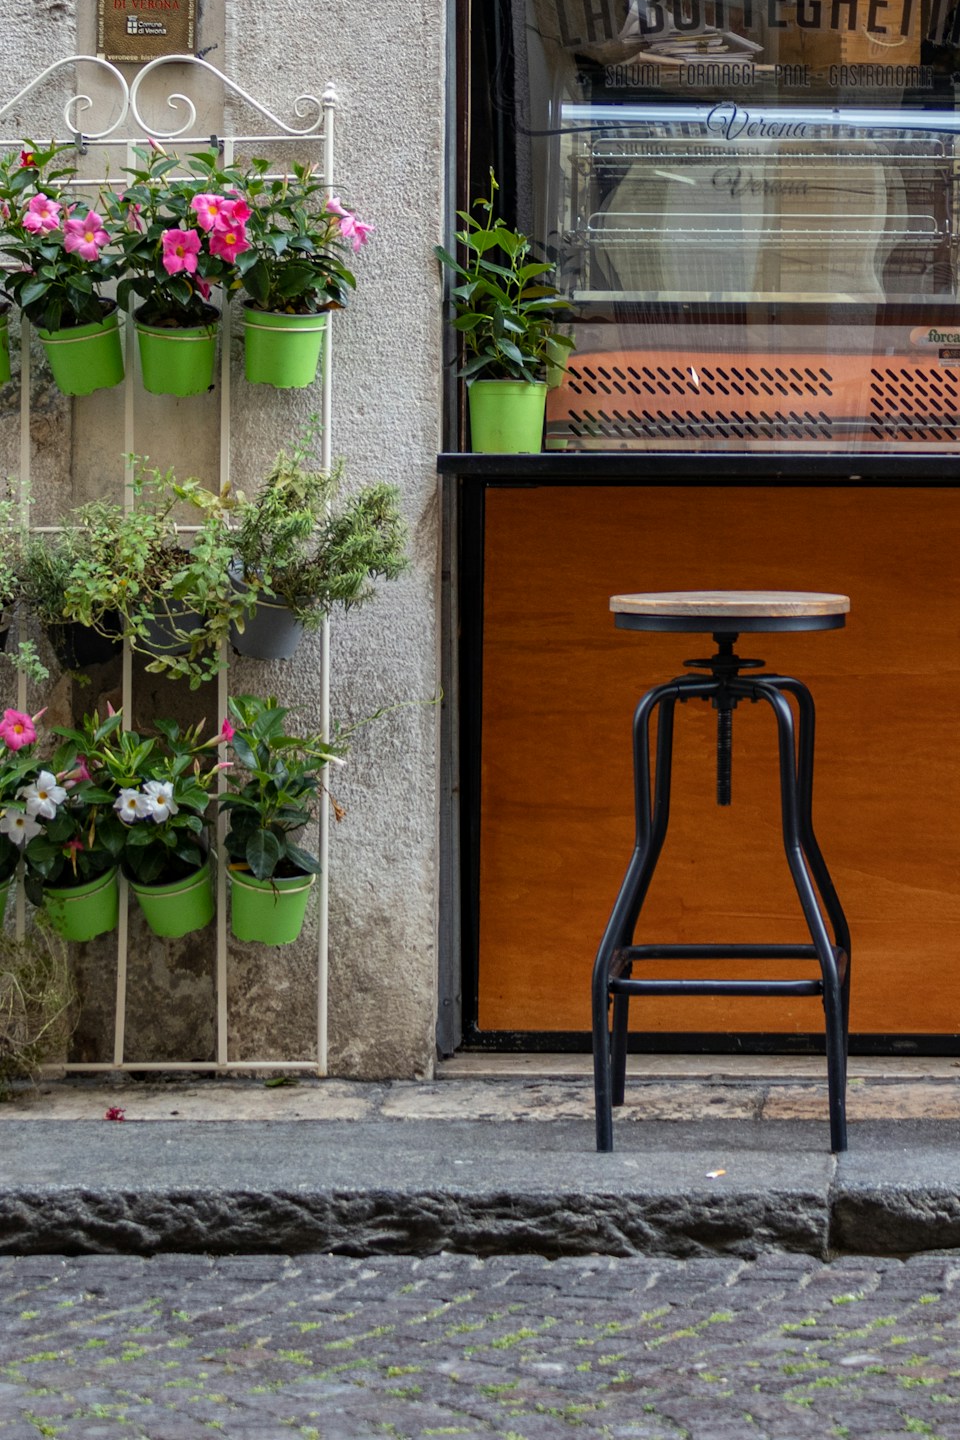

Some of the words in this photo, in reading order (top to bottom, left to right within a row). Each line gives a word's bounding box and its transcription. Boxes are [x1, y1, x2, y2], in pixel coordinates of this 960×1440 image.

[113, 0, 127, 10] DI
[132, 0, 180, 10] VERONA
[604, 64, 661, 88] SALUMI
[677, 64, 756, 88] FORMAGGI
[774, 64, 811, 88] PANE
[828, 64, 934, 89] GASTRONOMIA
[705, 101, 808, 141] Verona
